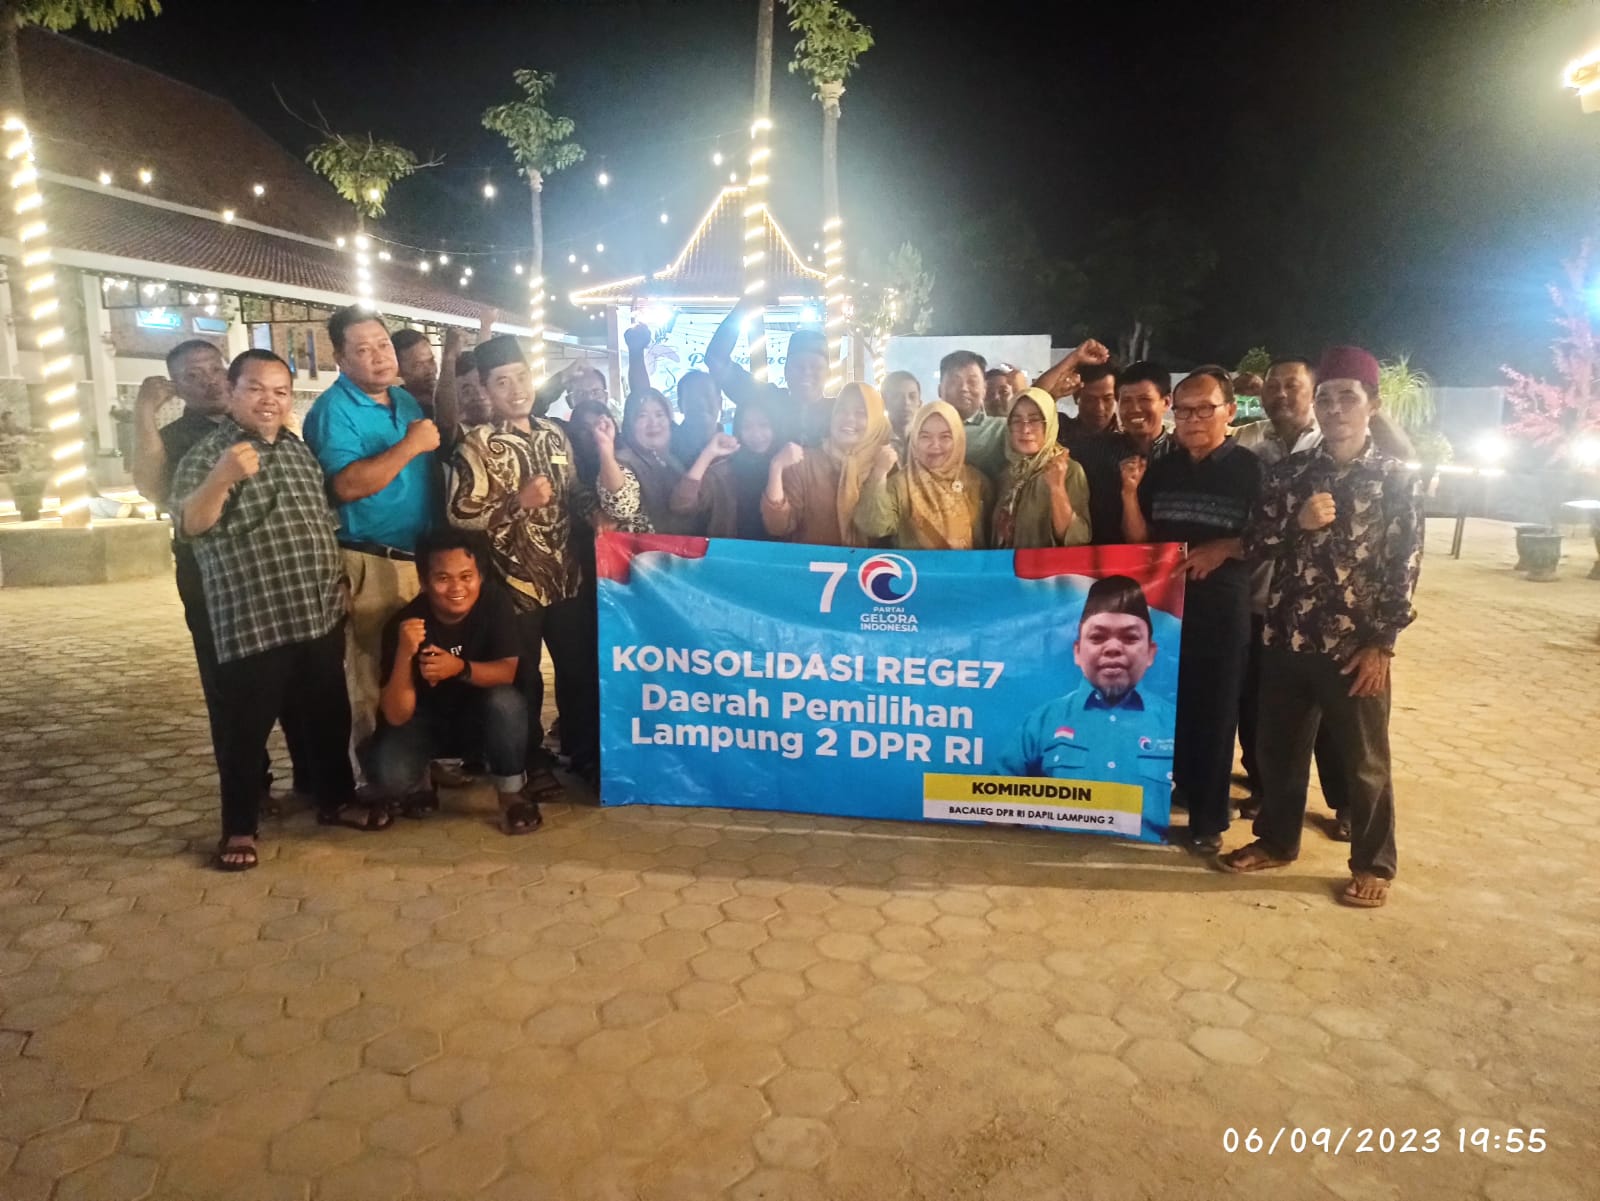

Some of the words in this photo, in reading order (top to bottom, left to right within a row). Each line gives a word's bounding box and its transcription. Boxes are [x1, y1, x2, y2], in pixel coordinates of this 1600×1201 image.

[809, 561, 848, 613] 7
[860, 613, 918, 624] GELORA
[860, 623, 919, 633] INDONESIA
[612, 645, 864, 682] KONSOLIDASI
[876, 655, 1005, 689] REGE7
[642, 683, 769, 718] Daerah
[782, 691, 973, 729] Pemilihan
[631, 717, 804, 759] Lampung
[815, 727, 838, 757] 2
[850, 730, 932, 763] DPR
[944, 735, 984, 765] RI
[972, 781, 1092, 801] KOMIRUDDIN
[949, 805, 993, 816] BACALEG
[996, 807, 1014, 817] DPR
[1016, 809, 1025, 818] RI
[1028, 810, 1055, 820] DAPIL
[1057, 813, 1105, 825] LAMPUNG
[1107, 816, 1115, 825] 2
